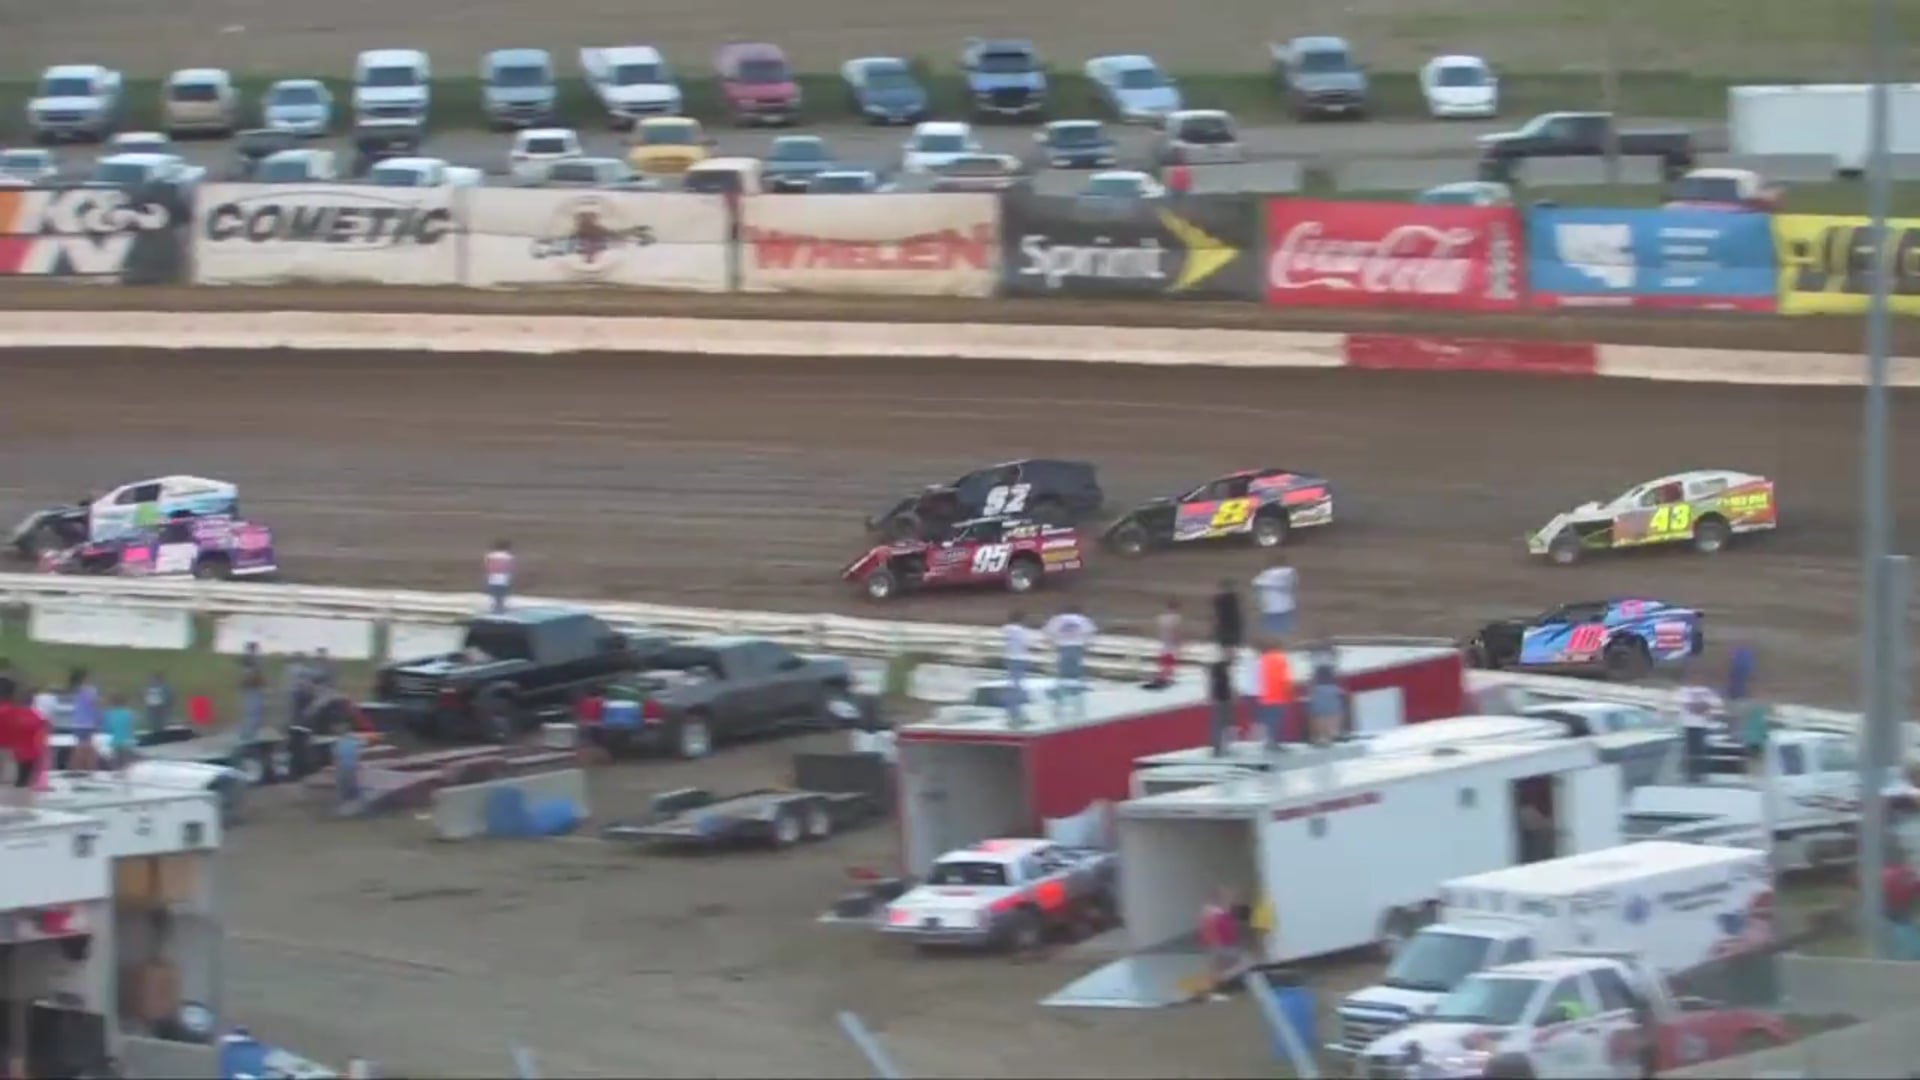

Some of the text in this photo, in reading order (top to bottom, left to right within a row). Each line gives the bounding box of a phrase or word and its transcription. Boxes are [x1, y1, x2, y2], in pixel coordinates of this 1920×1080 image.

[206, 202, 449, 244] COMETIC
[744, 223, 991, 269] WHELEN
[1018, 234, 1168, 288] Sprint
[1649, 504, 1691, 532] 43
[971, 543, 1014, 573] 95
